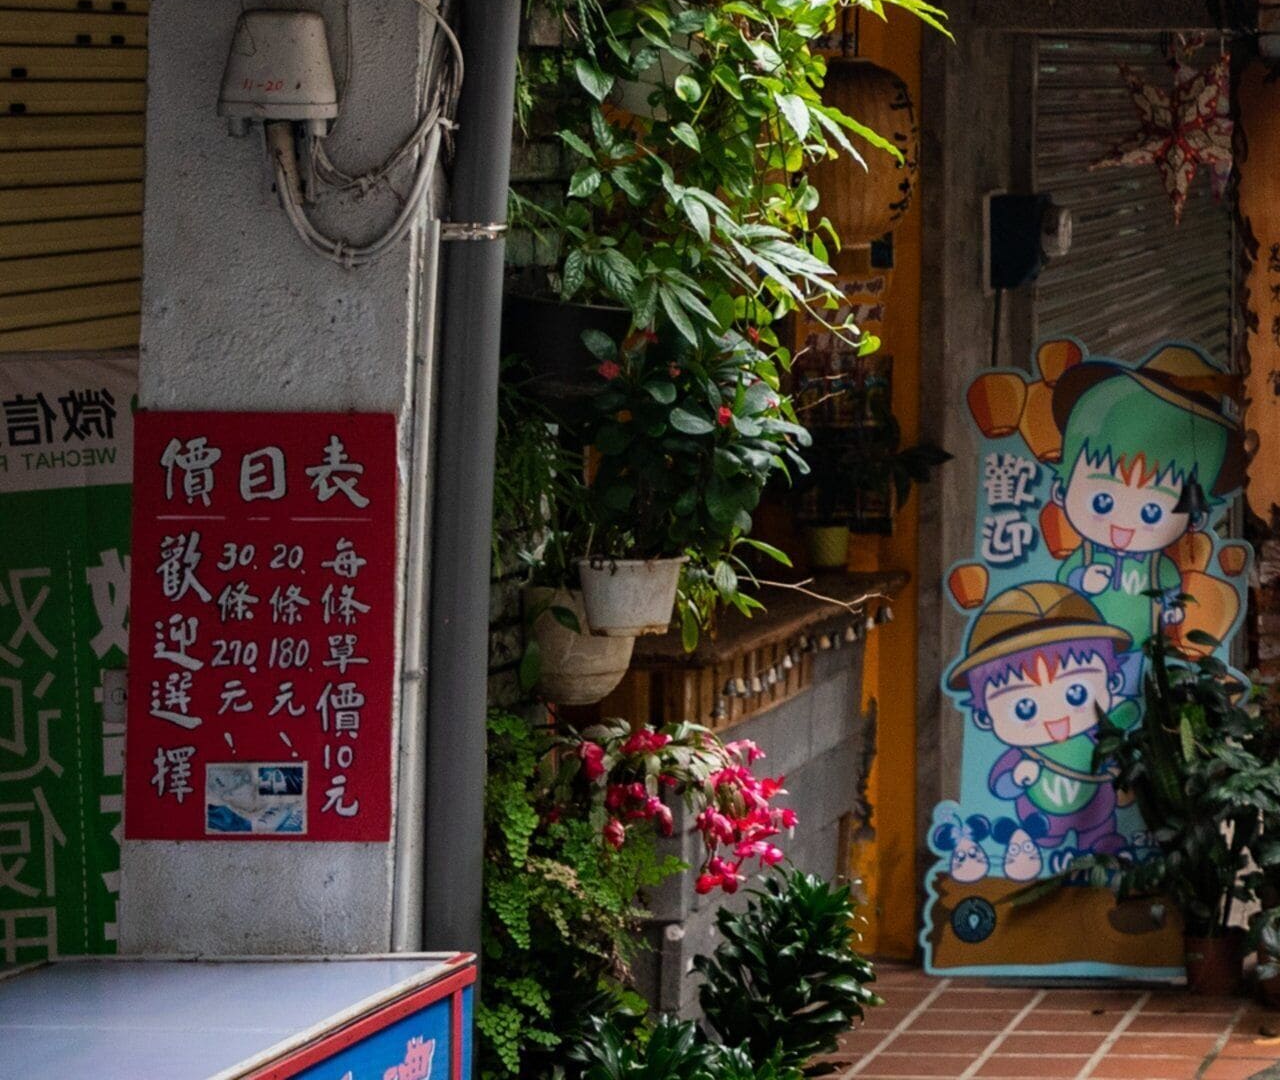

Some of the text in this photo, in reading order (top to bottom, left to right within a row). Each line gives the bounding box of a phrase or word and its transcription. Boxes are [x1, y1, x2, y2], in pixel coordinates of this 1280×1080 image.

[161, 435, 370, 510] 價目表
[982, 454, 1041, 565] 歡迎
[149, 532, 211, 803] 歡迎選擇
[316, 537, 371, 818] 每條單價10元
